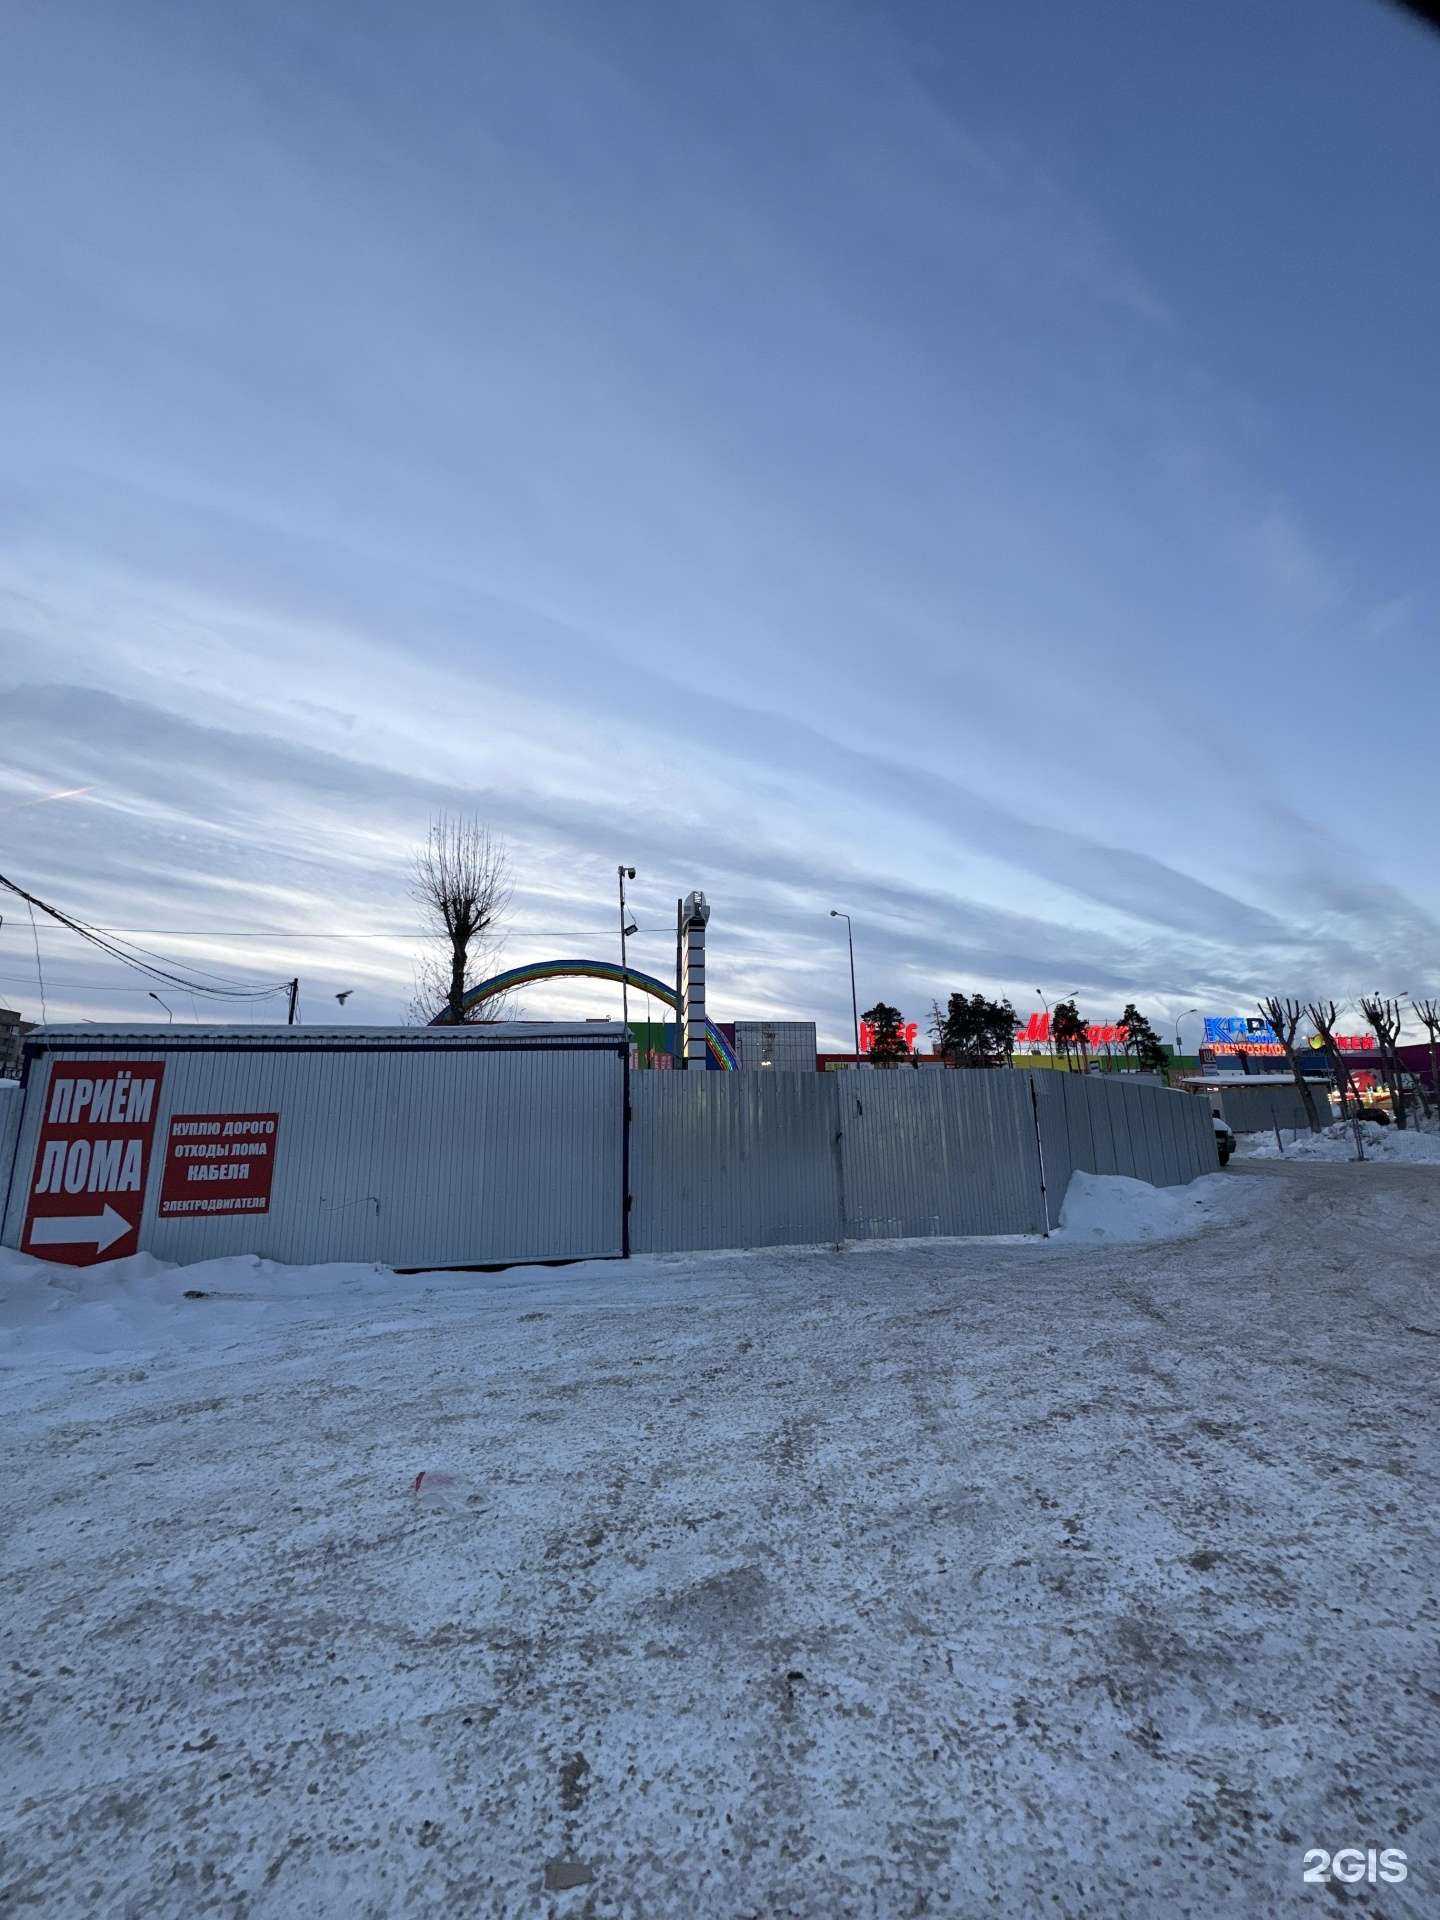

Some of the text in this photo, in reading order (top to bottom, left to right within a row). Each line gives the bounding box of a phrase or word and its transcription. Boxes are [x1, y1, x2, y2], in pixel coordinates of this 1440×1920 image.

[47, 1070, 157, 1124] ПРИЁМ
[172, 1120, 275, 1137] КУПЛЮ ДОРОГО
[174, 1142, 268, 1159] ОТХОДЫ ЛОМА
[34, 1139, 143, 1195] ЛОМА
[187, 1163, 250, 1181] КАБЕЛЯ
[162, 1197, 267, 1212] ЭЛЕКТРОДВИГАТЕЛЯ
